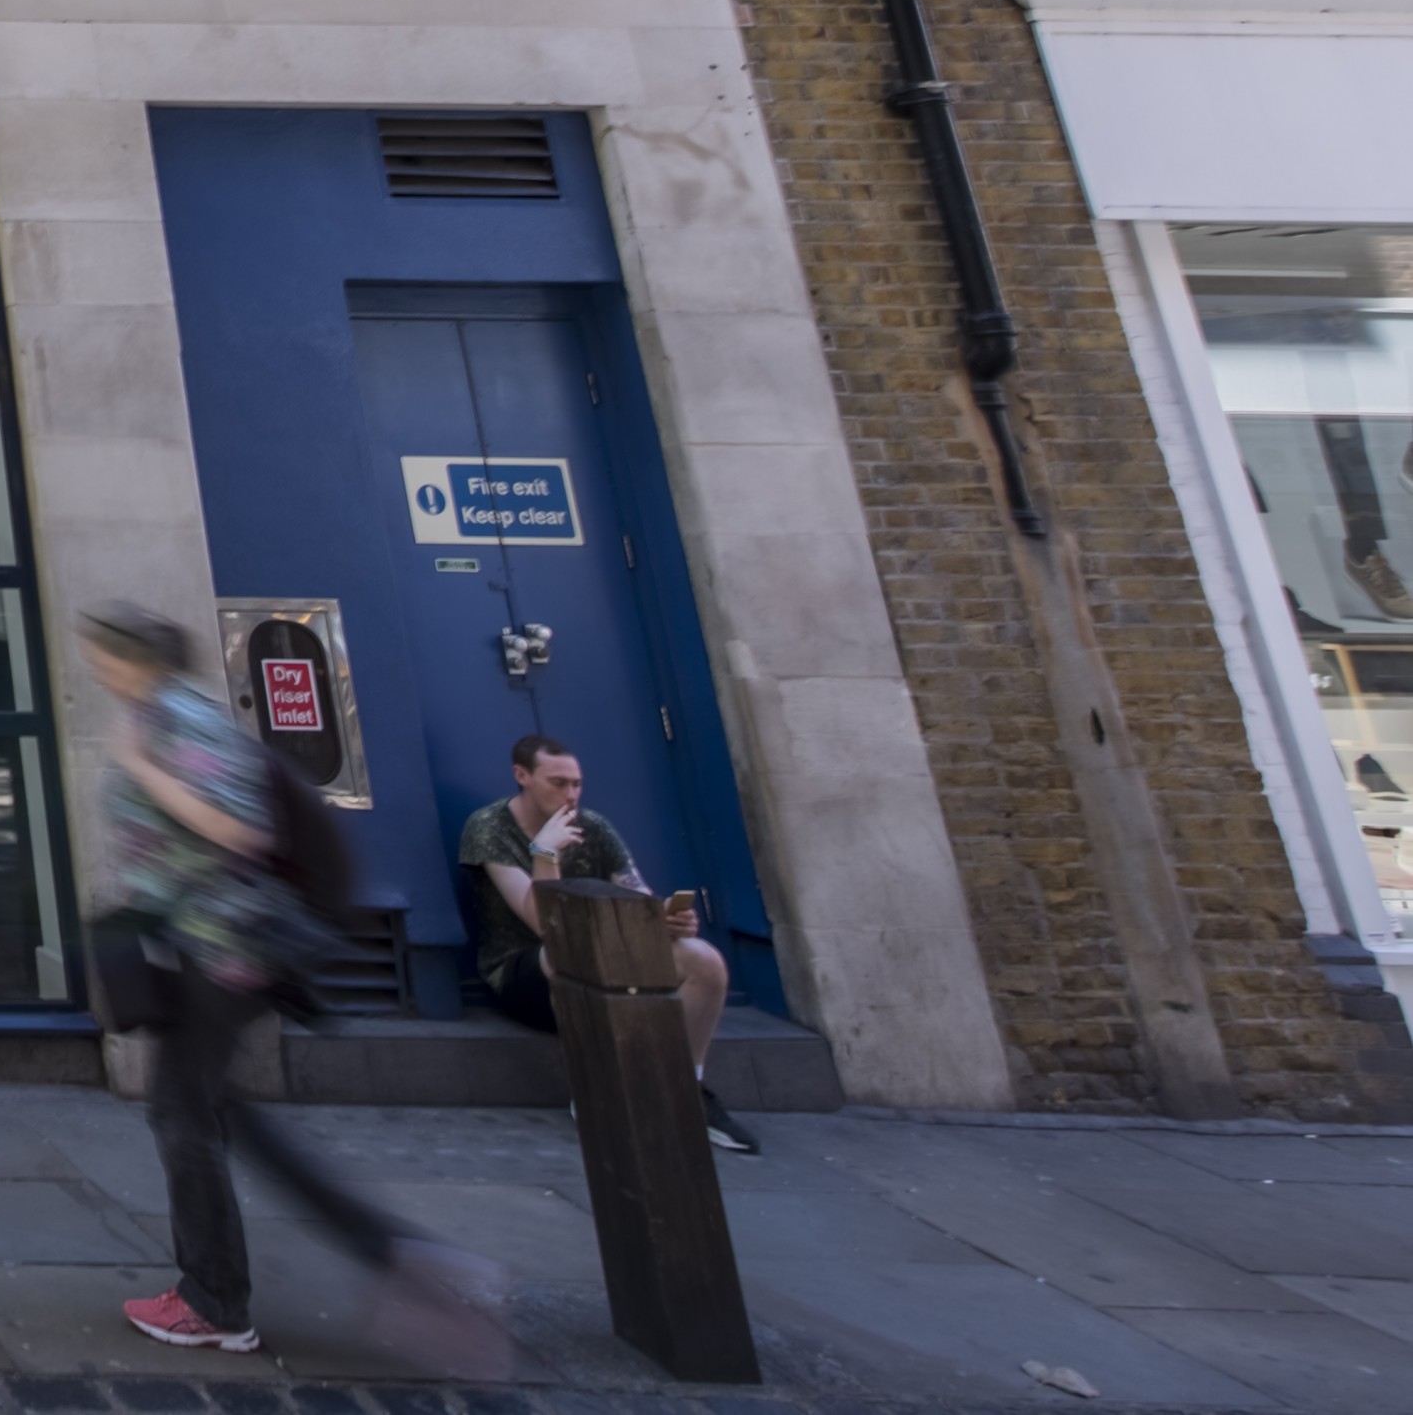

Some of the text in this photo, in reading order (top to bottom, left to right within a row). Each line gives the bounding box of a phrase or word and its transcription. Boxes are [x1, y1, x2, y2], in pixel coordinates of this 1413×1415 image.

[467, 477, 550, 496] Fire exit
[461, 507, 567, 528] Keep clear
[273, 666, 303, 685] Dry
[273, 688, 311, 704] riser
[277, 707, 314, 724] inlet
